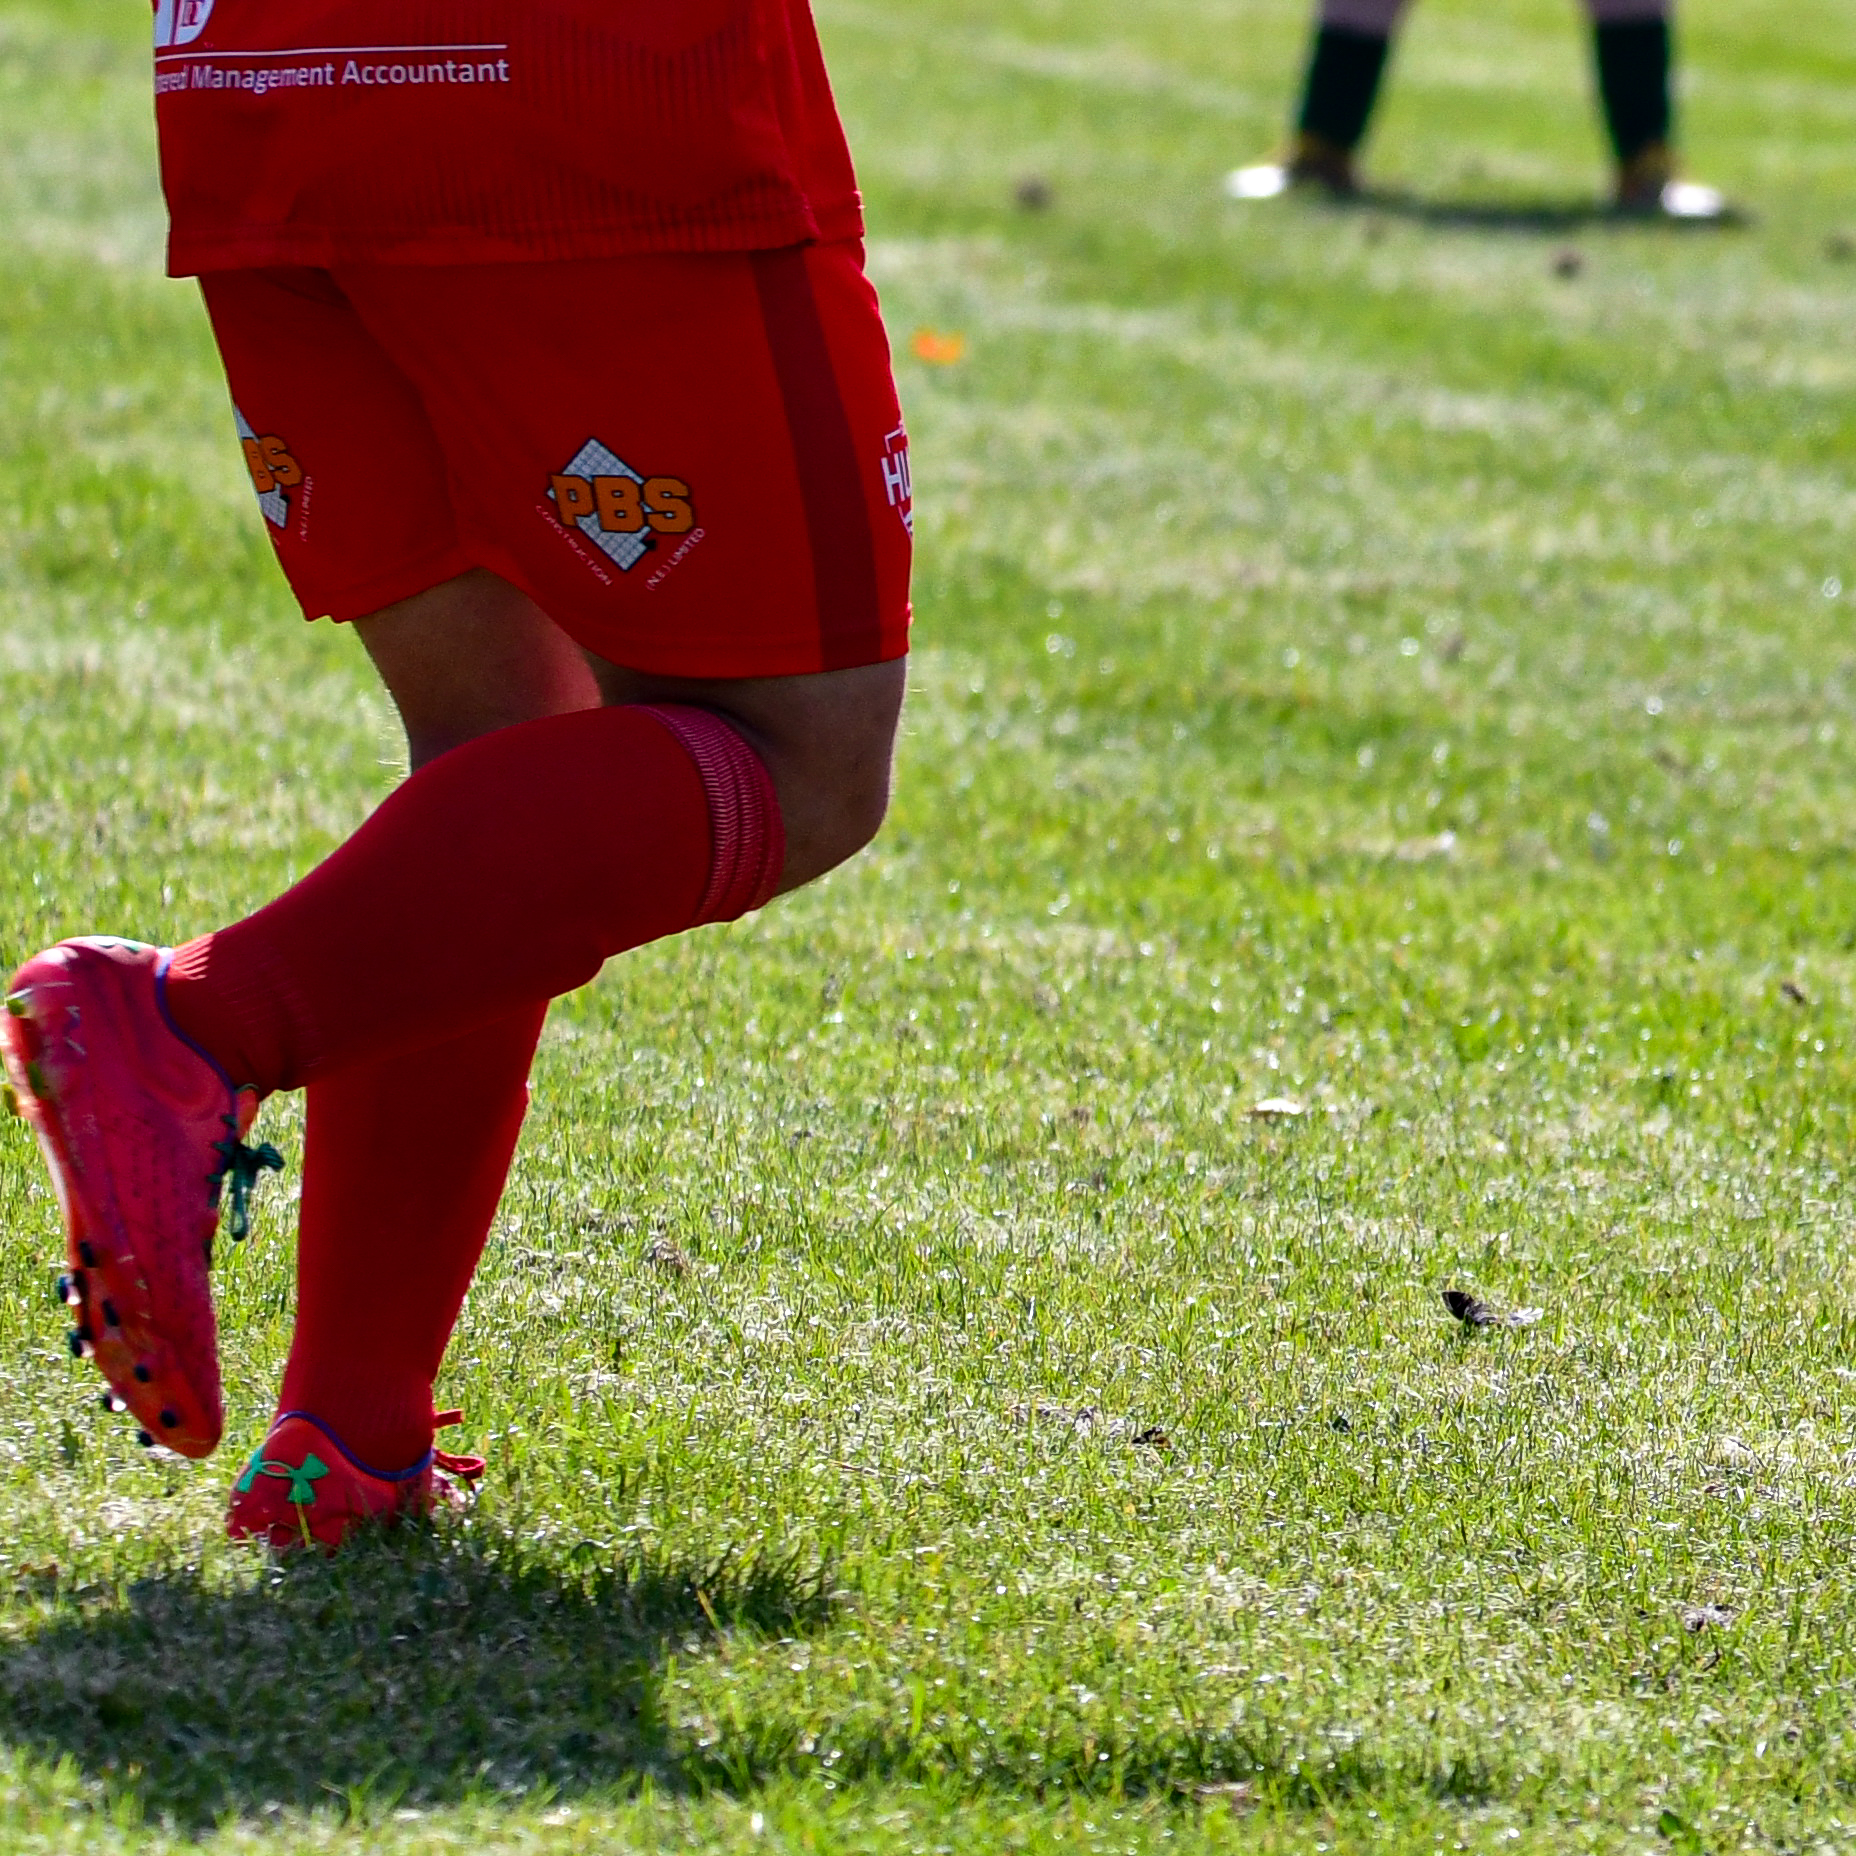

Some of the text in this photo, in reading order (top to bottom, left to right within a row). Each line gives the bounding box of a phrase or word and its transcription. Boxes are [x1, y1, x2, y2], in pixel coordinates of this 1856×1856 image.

[190, 62, 336, 95] Management
[341, 58, 510, 86] Accountant
[547, 473, 697, 535] PBS
